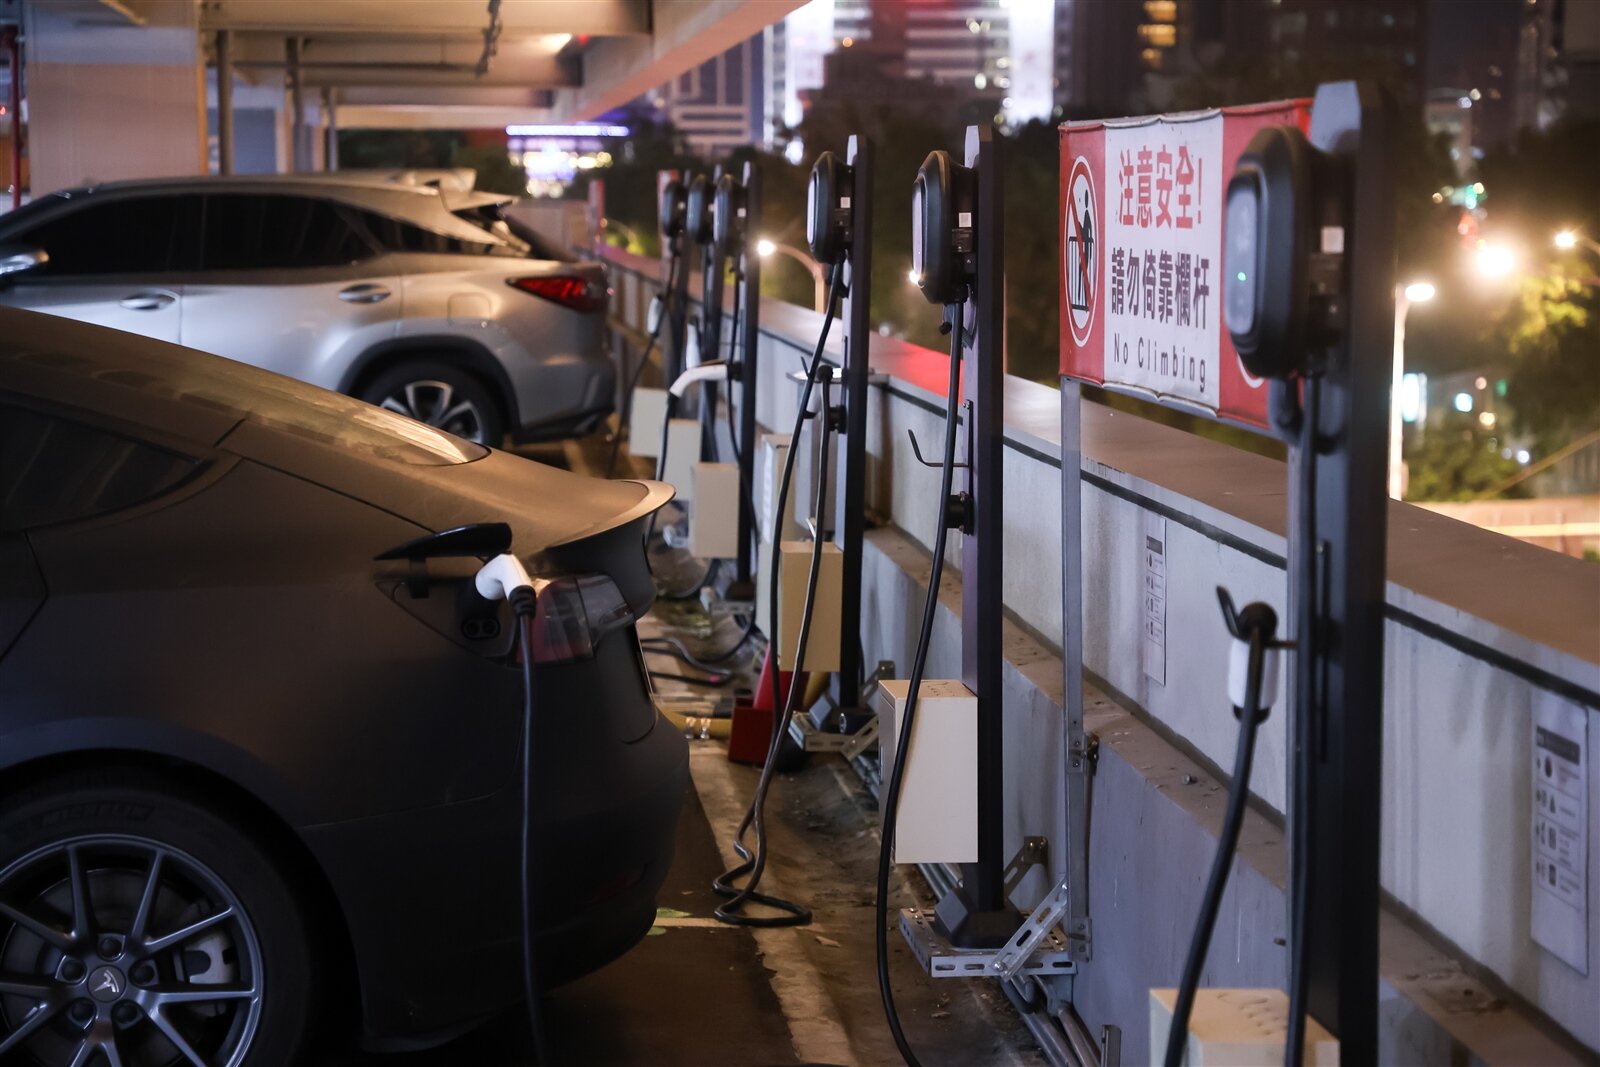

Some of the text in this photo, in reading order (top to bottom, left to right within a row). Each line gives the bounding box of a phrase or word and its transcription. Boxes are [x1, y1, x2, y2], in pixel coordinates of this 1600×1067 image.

[1119, 144, 1202, 229] 注意安全!
[1111, 247, 1210, 330] 請勿倚靠欄杆
[1114, 333, 1206, 393] No Climbing
